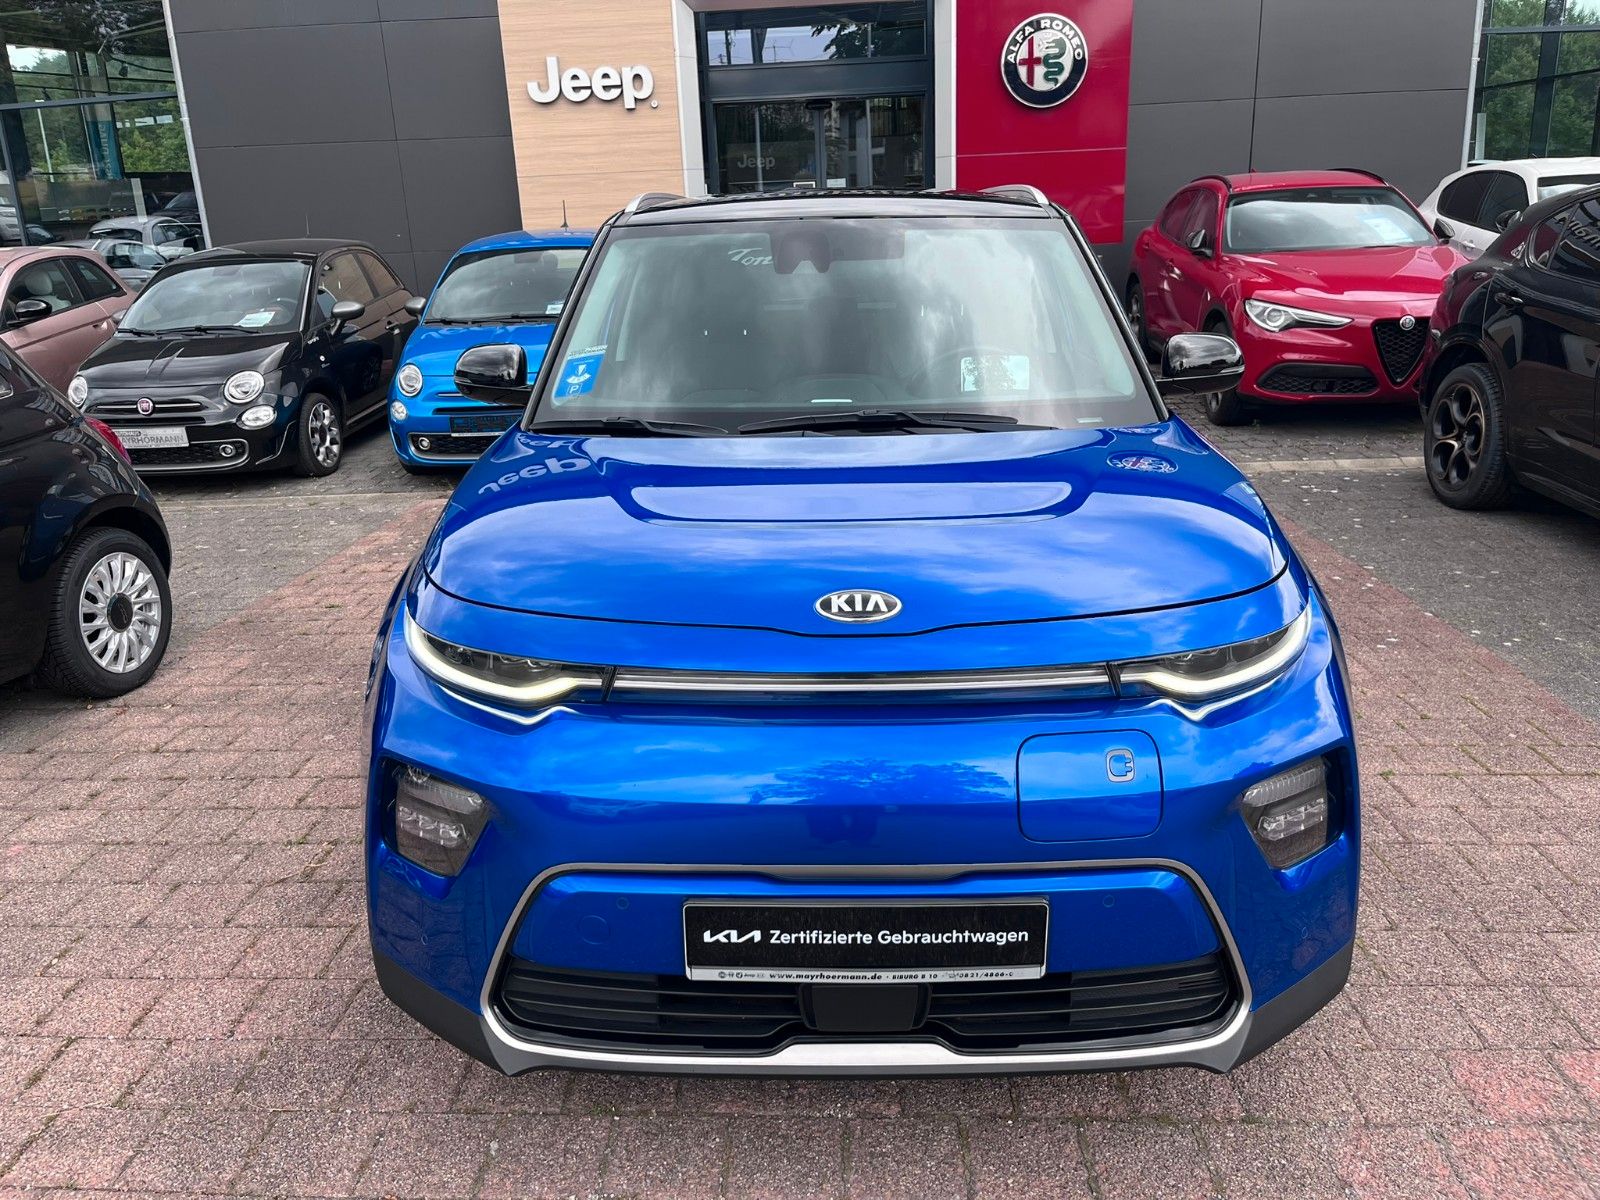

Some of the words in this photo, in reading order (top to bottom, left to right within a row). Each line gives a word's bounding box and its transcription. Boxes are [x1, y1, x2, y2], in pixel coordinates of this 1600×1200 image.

[1007, 25, 1035, 64] ALFA
[1040, 19, 1083, 60] ROMEO
[526, 56, 655, 110] Jeep
[737, 153, 776, 171] Jeep
[829, 593, 889, 613] KIA
[769, 930, 873, 944] Zertifizierte
[877, 929, 1029, 945] Gebrauchtwagen
[769, 972, 882, 981] www.mayrhoermann.de
